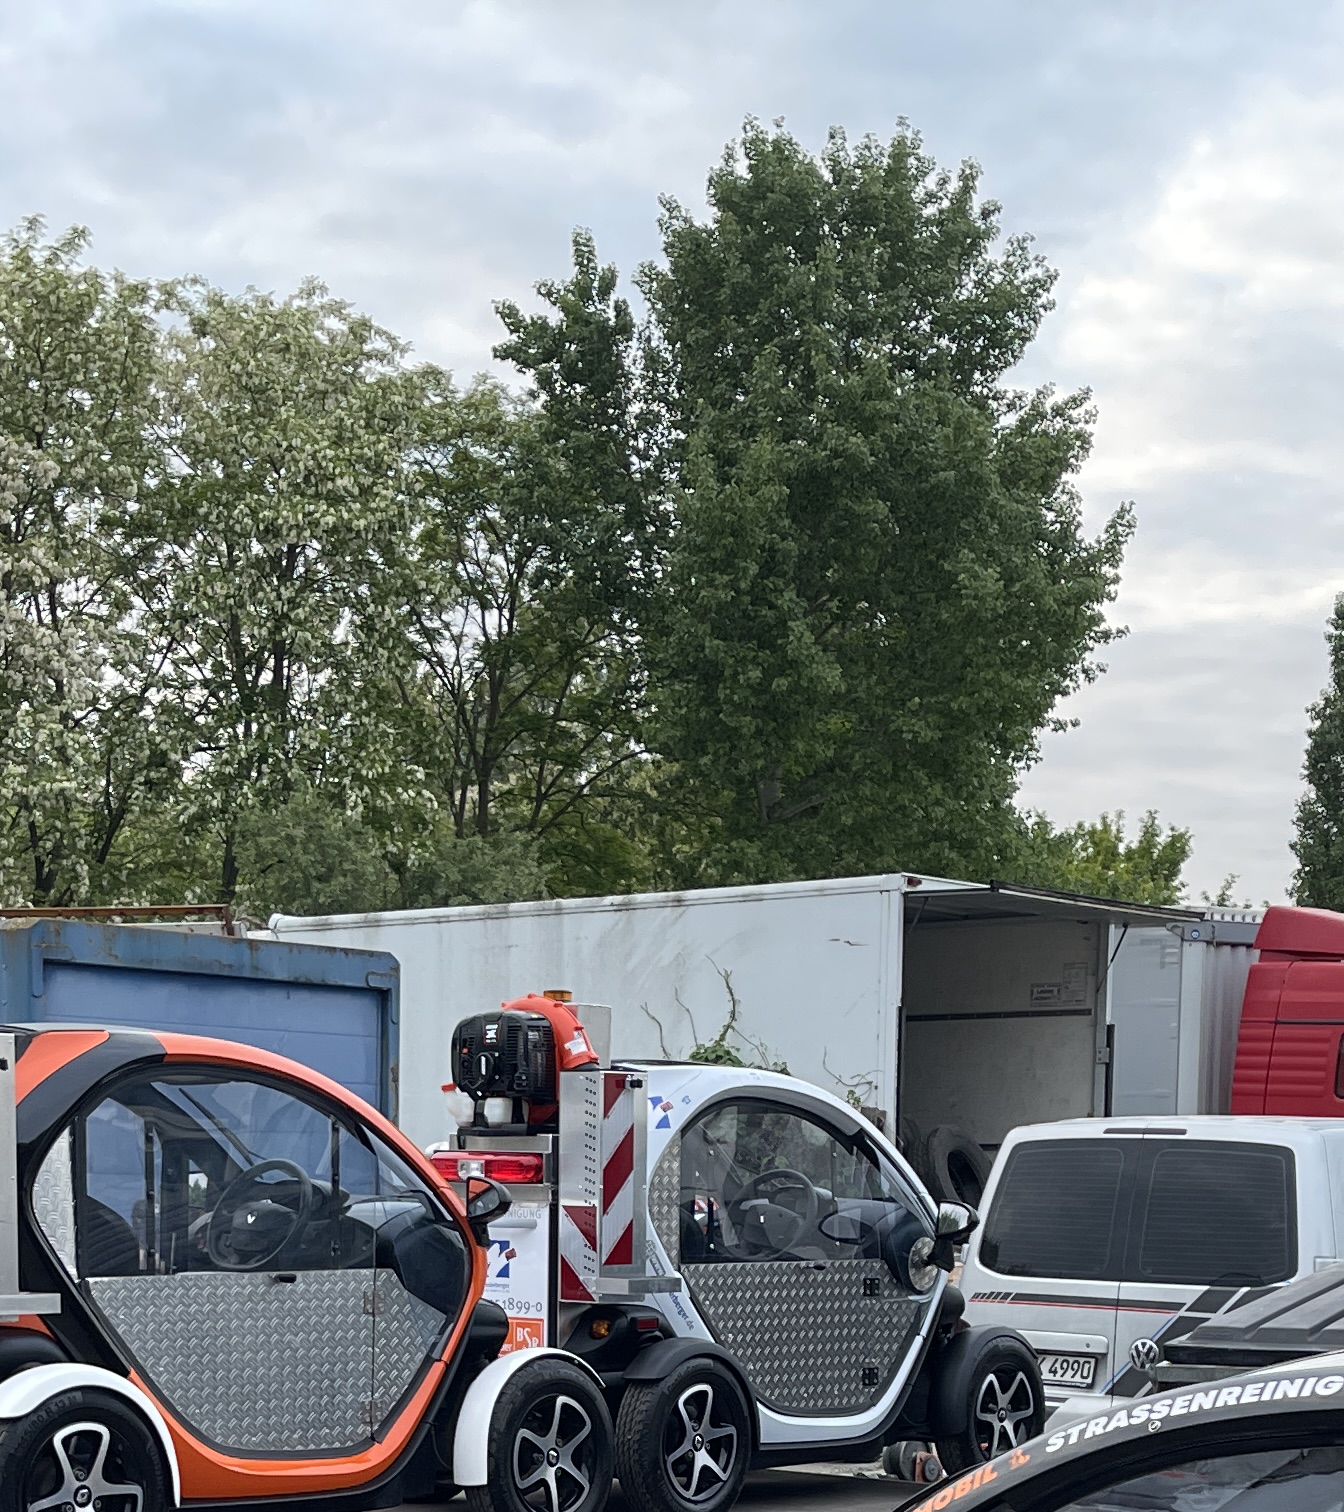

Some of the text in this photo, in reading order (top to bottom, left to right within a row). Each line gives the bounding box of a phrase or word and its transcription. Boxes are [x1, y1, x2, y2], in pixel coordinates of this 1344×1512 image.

[507, 1207, 542, 1219] NIGUNG
[490, 1297, 543, 1315] 1899-0
[1048, 1357, 1092, 1380] 4990
